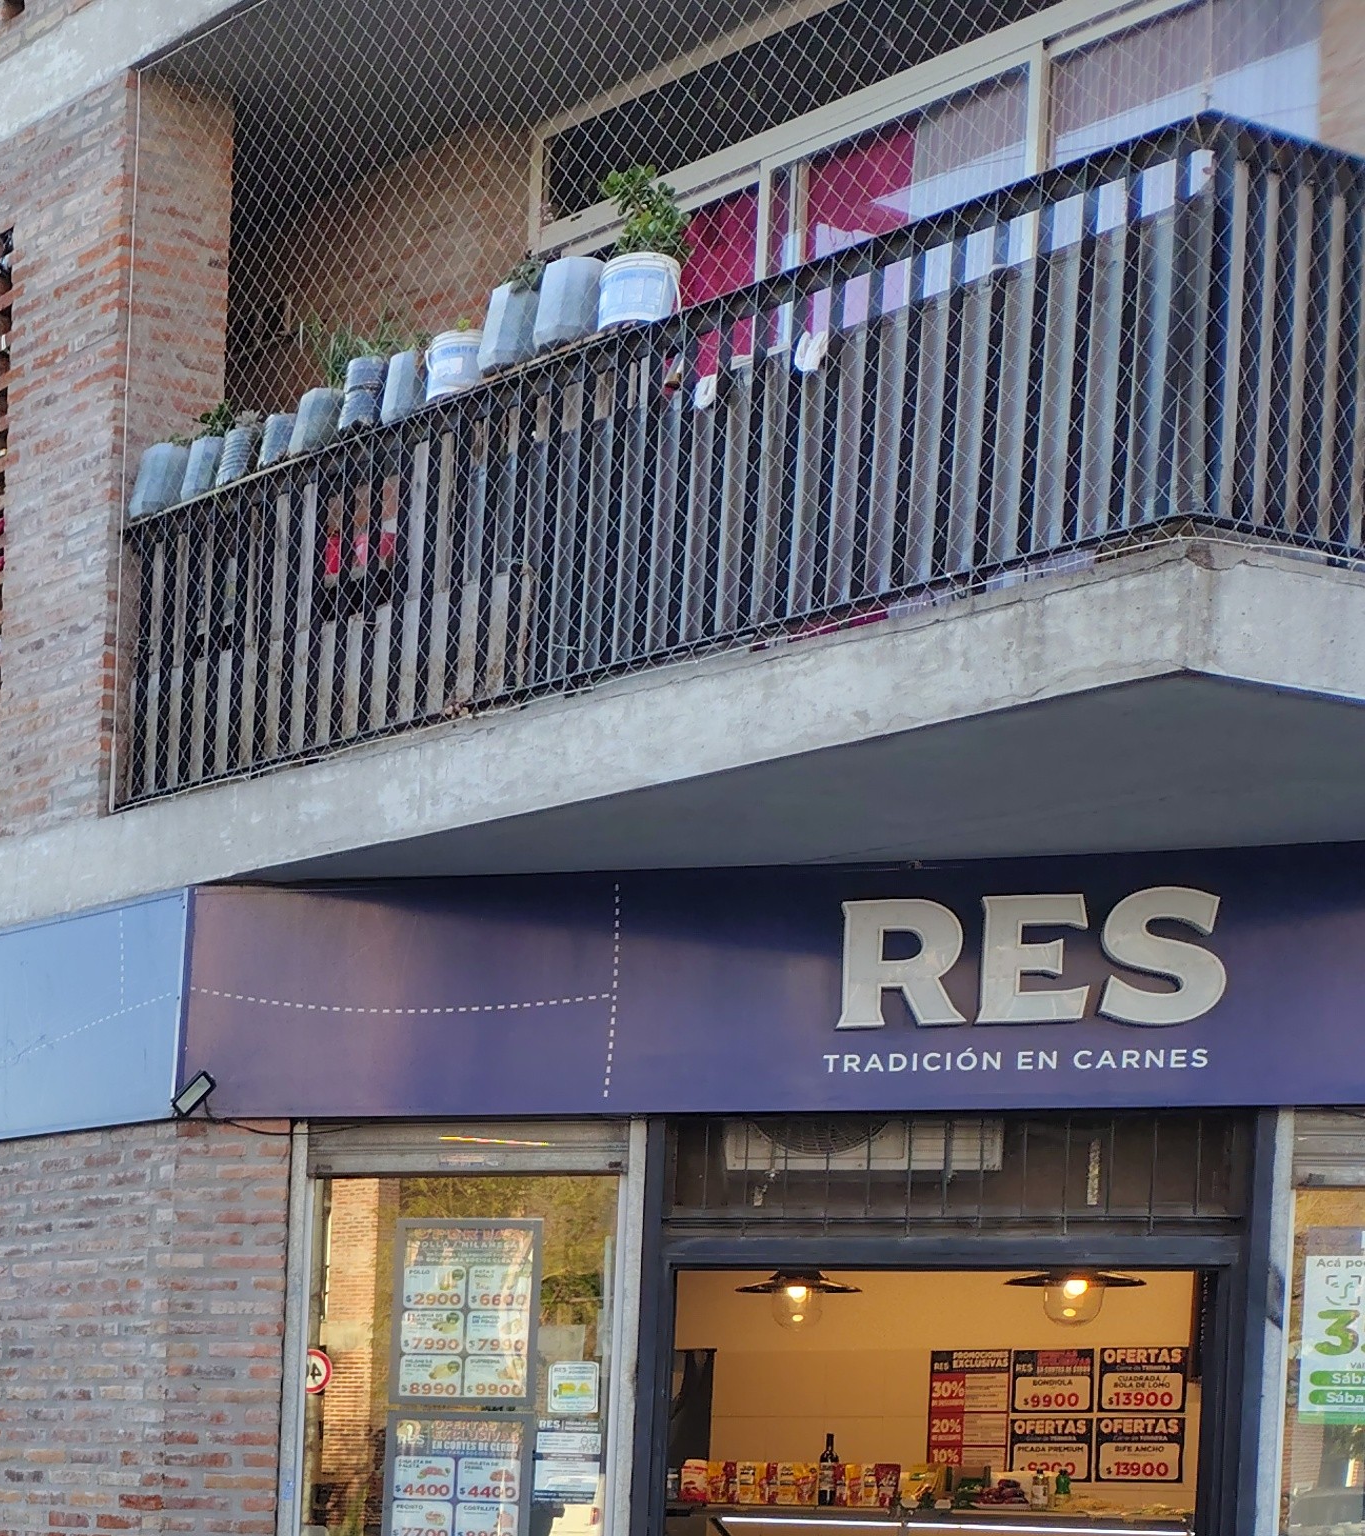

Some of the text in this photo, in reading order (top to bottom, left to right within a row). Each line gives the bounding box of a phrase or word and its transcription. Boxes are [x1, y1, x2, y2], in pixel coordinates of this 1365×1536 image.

[835, 886, 1227, 1030] RES
[823, 1047, 1209, 1074] TRADICIÓN EN CARNES
[1316, 1257, 1341, 1268] Acá
[1314, 1309, 1365, 1356] 3
[952, 1358, 1009, 1369] EXCLUSIVAS
[1103, 1349, 1183, 1363] OFERTAS
[931, 1380, 965, 1398] 30%
[931, 1418, 962, 1433] 20%
[1014, 1420, 1086, 1435] OFERTAS
[1099, 1419, 1179, 1434] OFERTAS
[444, 1441, 477, 1451] CORTES
[932, 1449, 960, 1463] 10%
